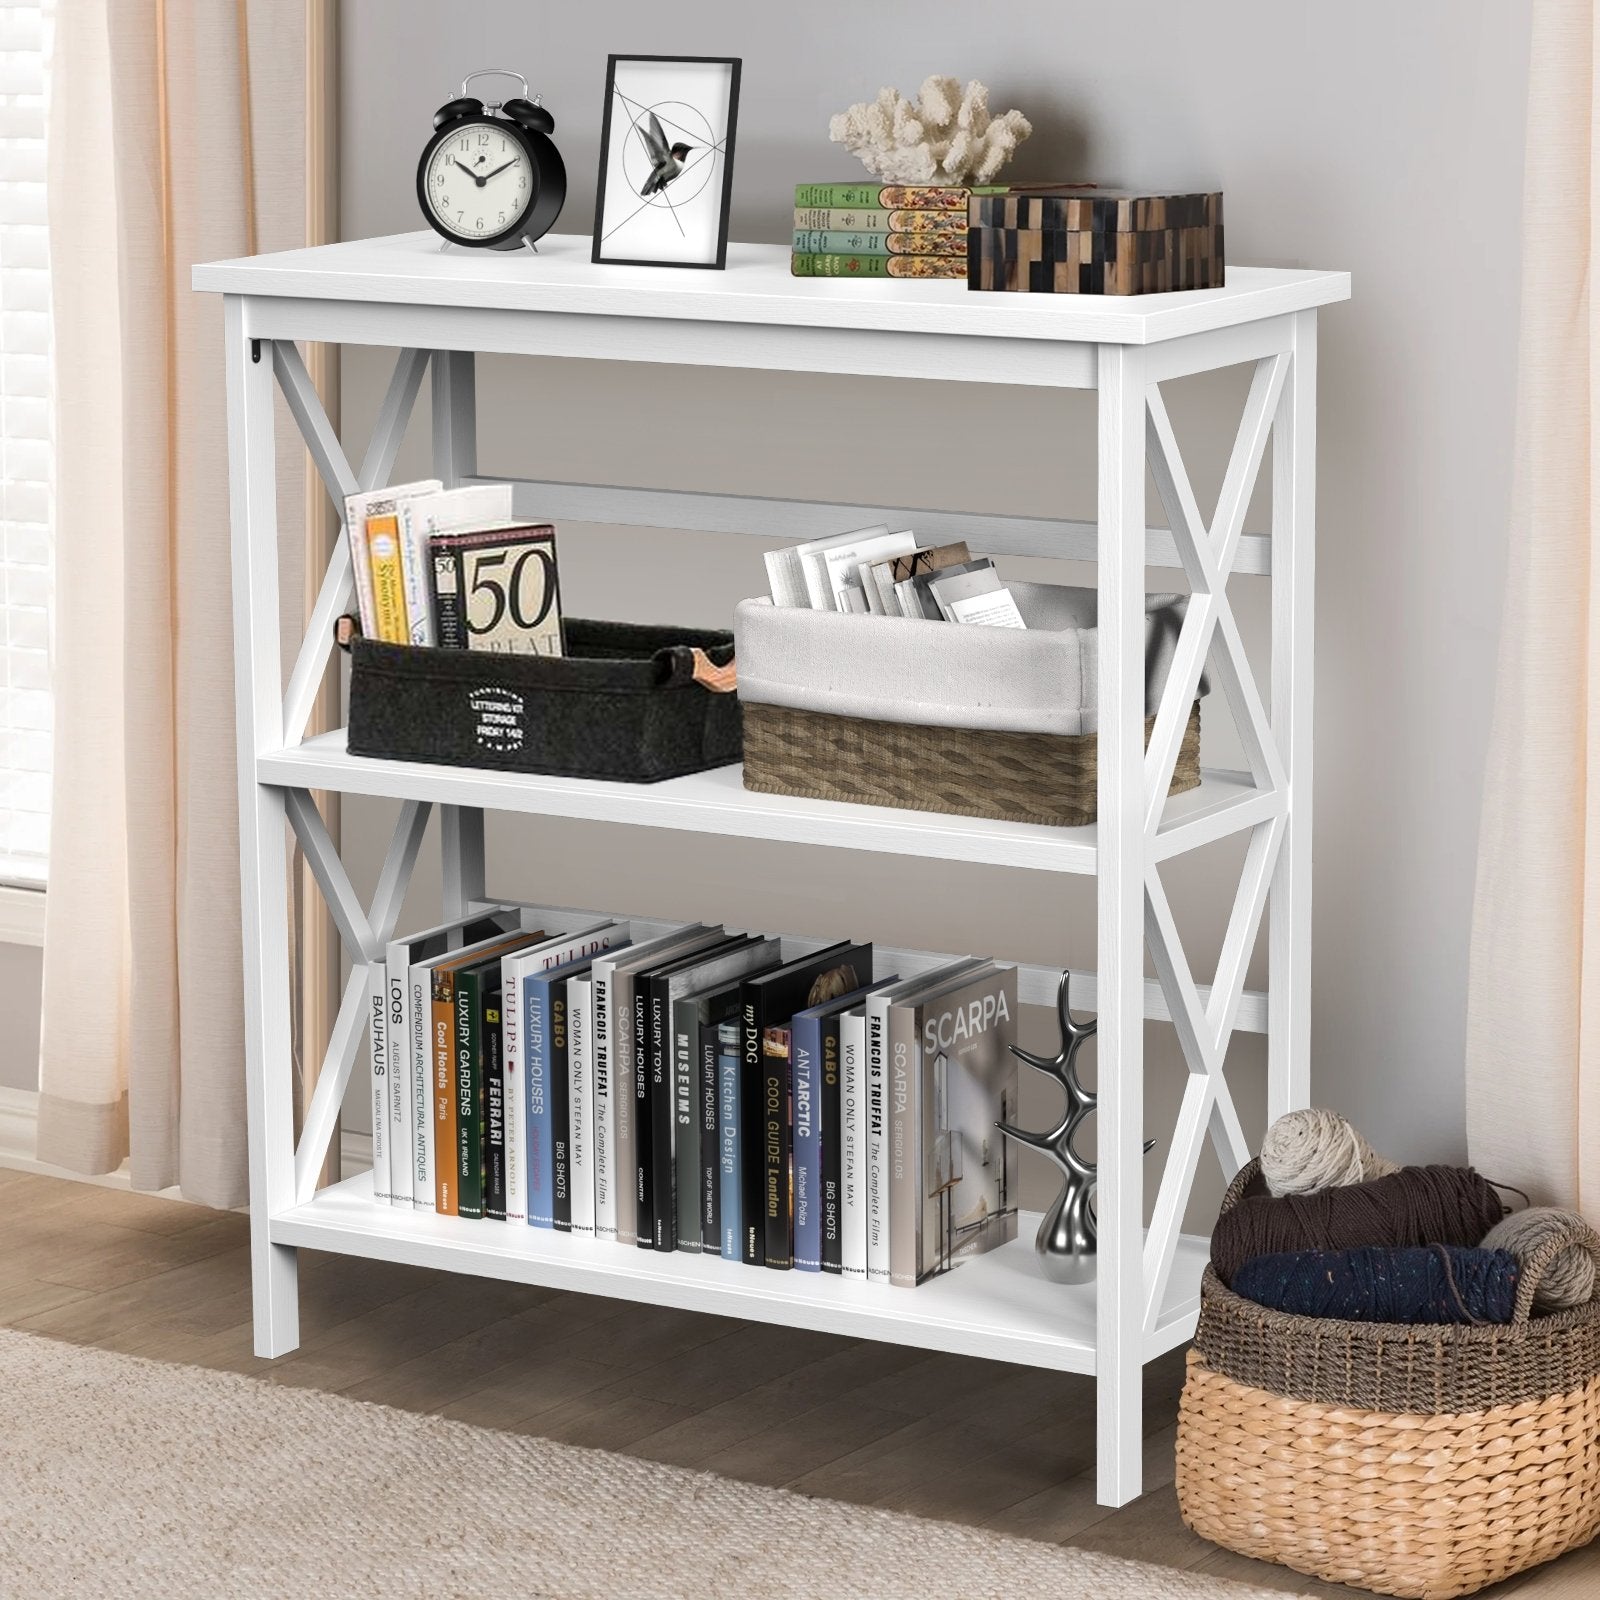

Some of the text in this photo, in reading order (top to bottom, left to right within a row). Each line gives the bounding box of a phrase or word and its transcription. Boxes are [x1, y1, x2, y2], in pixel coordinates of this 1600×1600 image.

[445, 154, 456, 166] 10
[460, 139, 469, 152] 11
[478, 134, 489, 146] 12
[502, 140, 506, 152] 1
[437, 174, 445, 187] 9
[442, 195, 450, 208] 8
[512, 198, 519, 210] 4
[518, 176, 526, 188] 3
[457, 211, 464, 223] 7
[476, 217, 484, 230] 6
[498, 212, 506, 224] 5
[436, 558, 454, 574] 50
[466, 549, 556, 635] 50
[390, 978, 402, 1024] LOOS
[505, 977, 516, 1054] TULIPS
[553, 1000, 565, 1048] GABO
[925, 990, 1010, 1054] SCARPA
[372, 996, 385, 1076] BAUHAUS
[437, 1022, 447, 1089] Cool Hotels
[458, 990, 471, 1116] LUXURY GARDENS
[530, 997, 543, 1114] LUXURY HOUSES
[572, 1009, 582, 1056] WOMAN
[596, 980, 608, 1098] FRANCOIS TRUFFAT
[618, 1006, 629, 1076] SCARPA
[636, 995, 645, 1098] LUXURY HOUSES
[653, 998, 662, 1083] LUXURY TOYS
[743, 1004, 758, 1064] my DOG
[825, 1036, 836, 1085] GABO
[414, 984, 426, 1182] COMPENDIUM ARCHITECTURAL ANTIQUES
[573, 1060, 582, 1093] ONLY
[677, 1034, 690, 1125] MUSEUMS
[704, 1044, 715, 1130] LUXURY HOUSES
[797, 1048, 810, 1137] ANTARCTIC
[846, 1044, 854, 1094] WOMAN
[870, 1016, 882, 1136] FRANCOIS TRUFFAT
[895, 1042, 907, 1114] SCARPA
[439, 1097, 448, 1120] Paris
[461, 1127, 468, 1138] UK
[489, 1077, 502, 1146] FERRARI
[722, 1066, 736, 1174] Kitchen Design
[846, 1098, 855, 1132] ONLY
[556, 1141, 566, 1198] BIG SHOTS
[597, 1103, 607, 1205] The Complete Films
[767, 1077, 780, 1217] COOL GUIDE London
[895, 1120, 903, 1180] SERGIO LOS
[798, 1166, 807, 1226] Michael Poliza
[826, 1181, 836, 1240] BIG SHOTS
[870, 1142, 880, 1247] The Complete Films
